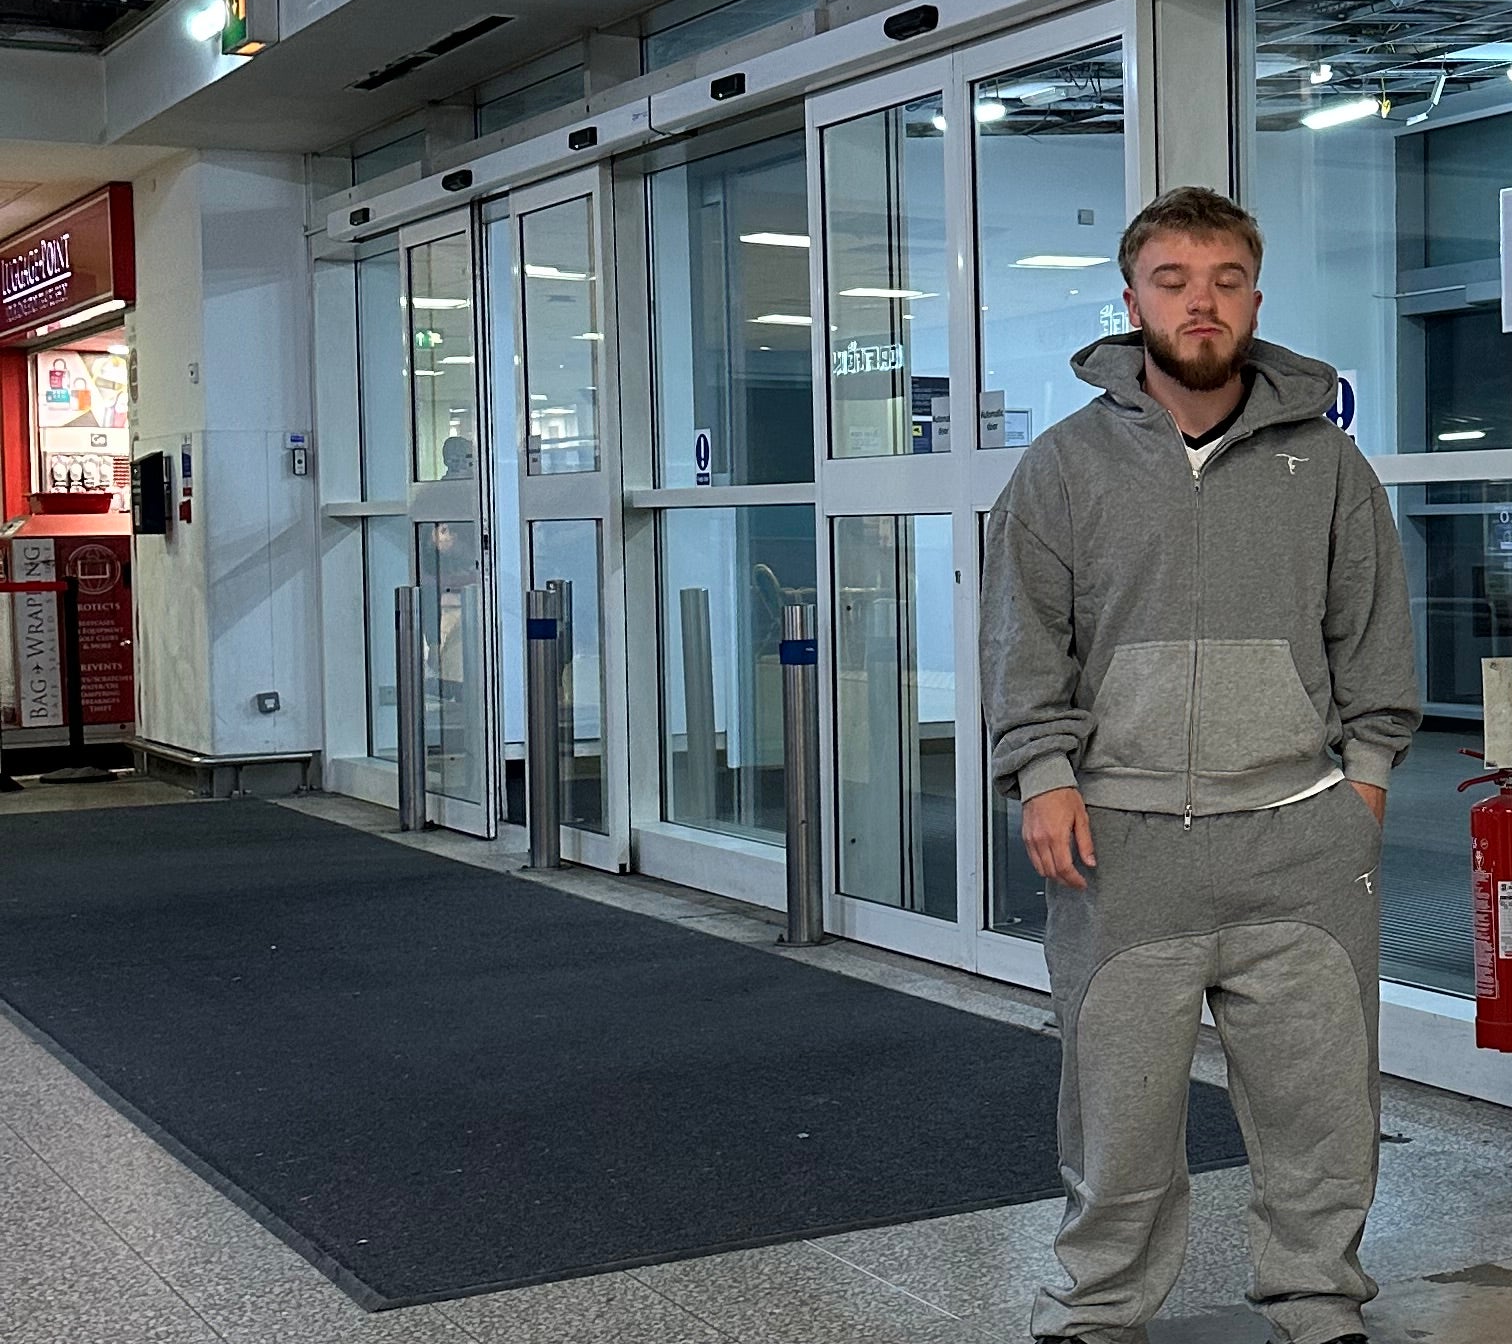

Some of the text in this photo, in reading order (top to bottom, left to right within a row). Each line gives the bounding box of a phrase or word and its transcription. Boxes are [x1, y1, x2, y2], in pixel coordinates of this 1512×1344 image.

[77, 602, 121, 612] ROTECTS
[24, 547, 48, 720] BAG WRAPNG
[80, 663, 122, 672] REVENTS
